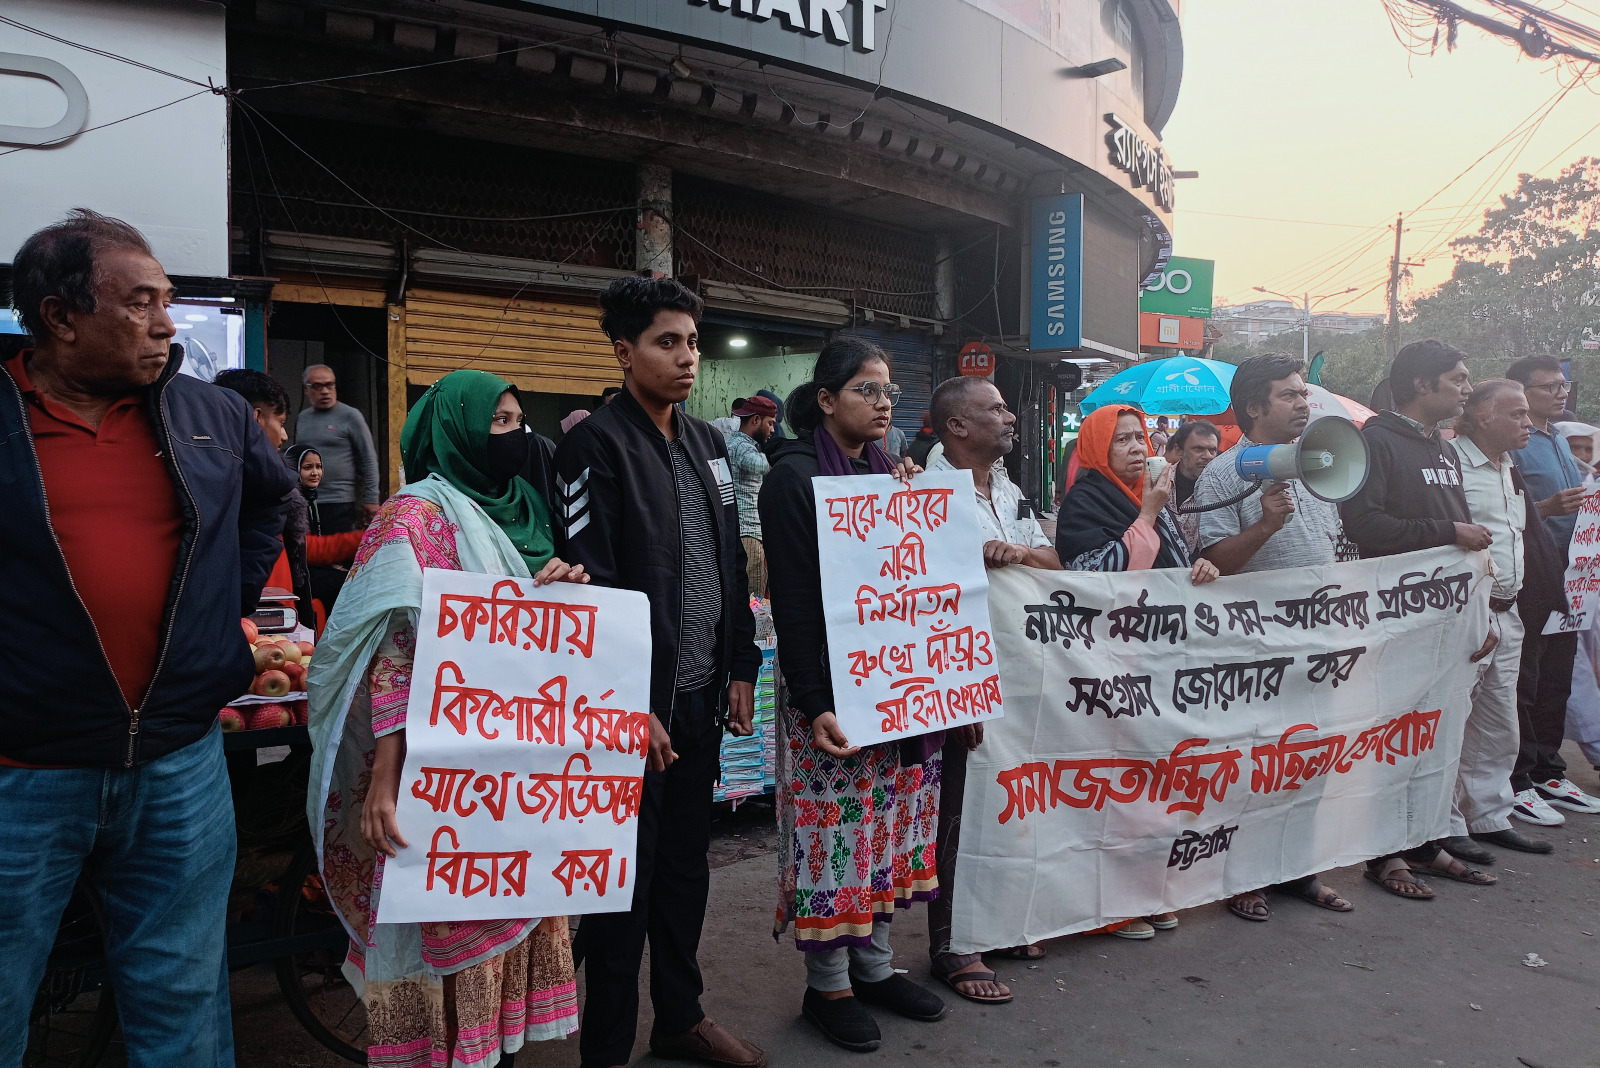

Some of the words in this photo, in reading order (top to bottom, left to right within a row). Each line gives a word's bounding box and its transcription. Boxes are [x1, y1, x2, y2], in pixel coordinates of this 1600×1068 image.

[1047, 210, 1066, 336] SAMSUNG
[962, 348, 989, 367] ria
[825, 481, 954, 542] ঘরে-বাইরে
[877, 531, 927, 581] নারী
[437, 579, 598, 658] চকরিয়ায়
[855, 583, 961, 626] নির্যাতন
[1024, 590, 1102, 650] নারীর
[1107, 588, 1187, 644] মর্যাদা
[1194, 602, 1220, 636] ও
[1376, 566, 1473, 621] প্রতিষ্ঠার
[848, 643, 916, 687] রুখে
[927, 619, 993, 674] দাঁড়াও
[1066, 673, 1161, 718] সংগ্রাম
[1172, 656, 1294, 713] জোরদার
[1307, 646, 1366, 688] কর
[430, 661, 568, 747] কিশোরী
[876, 677, 946, 733] মহিলা
[947, 674, 1002, 719] ফোরাম
[411, 767, 516, 821] সাথে
[996, 737, 1243, 825] সমাজতান্ত্রিক
[1251, 723, 1347, 794] মহিলা
[1335, 709, 1442, 773] ফোরাম
[425, 825, 532, 898] বিচার
[1167, 824, 1239, 871] চট্টগ্রাম
